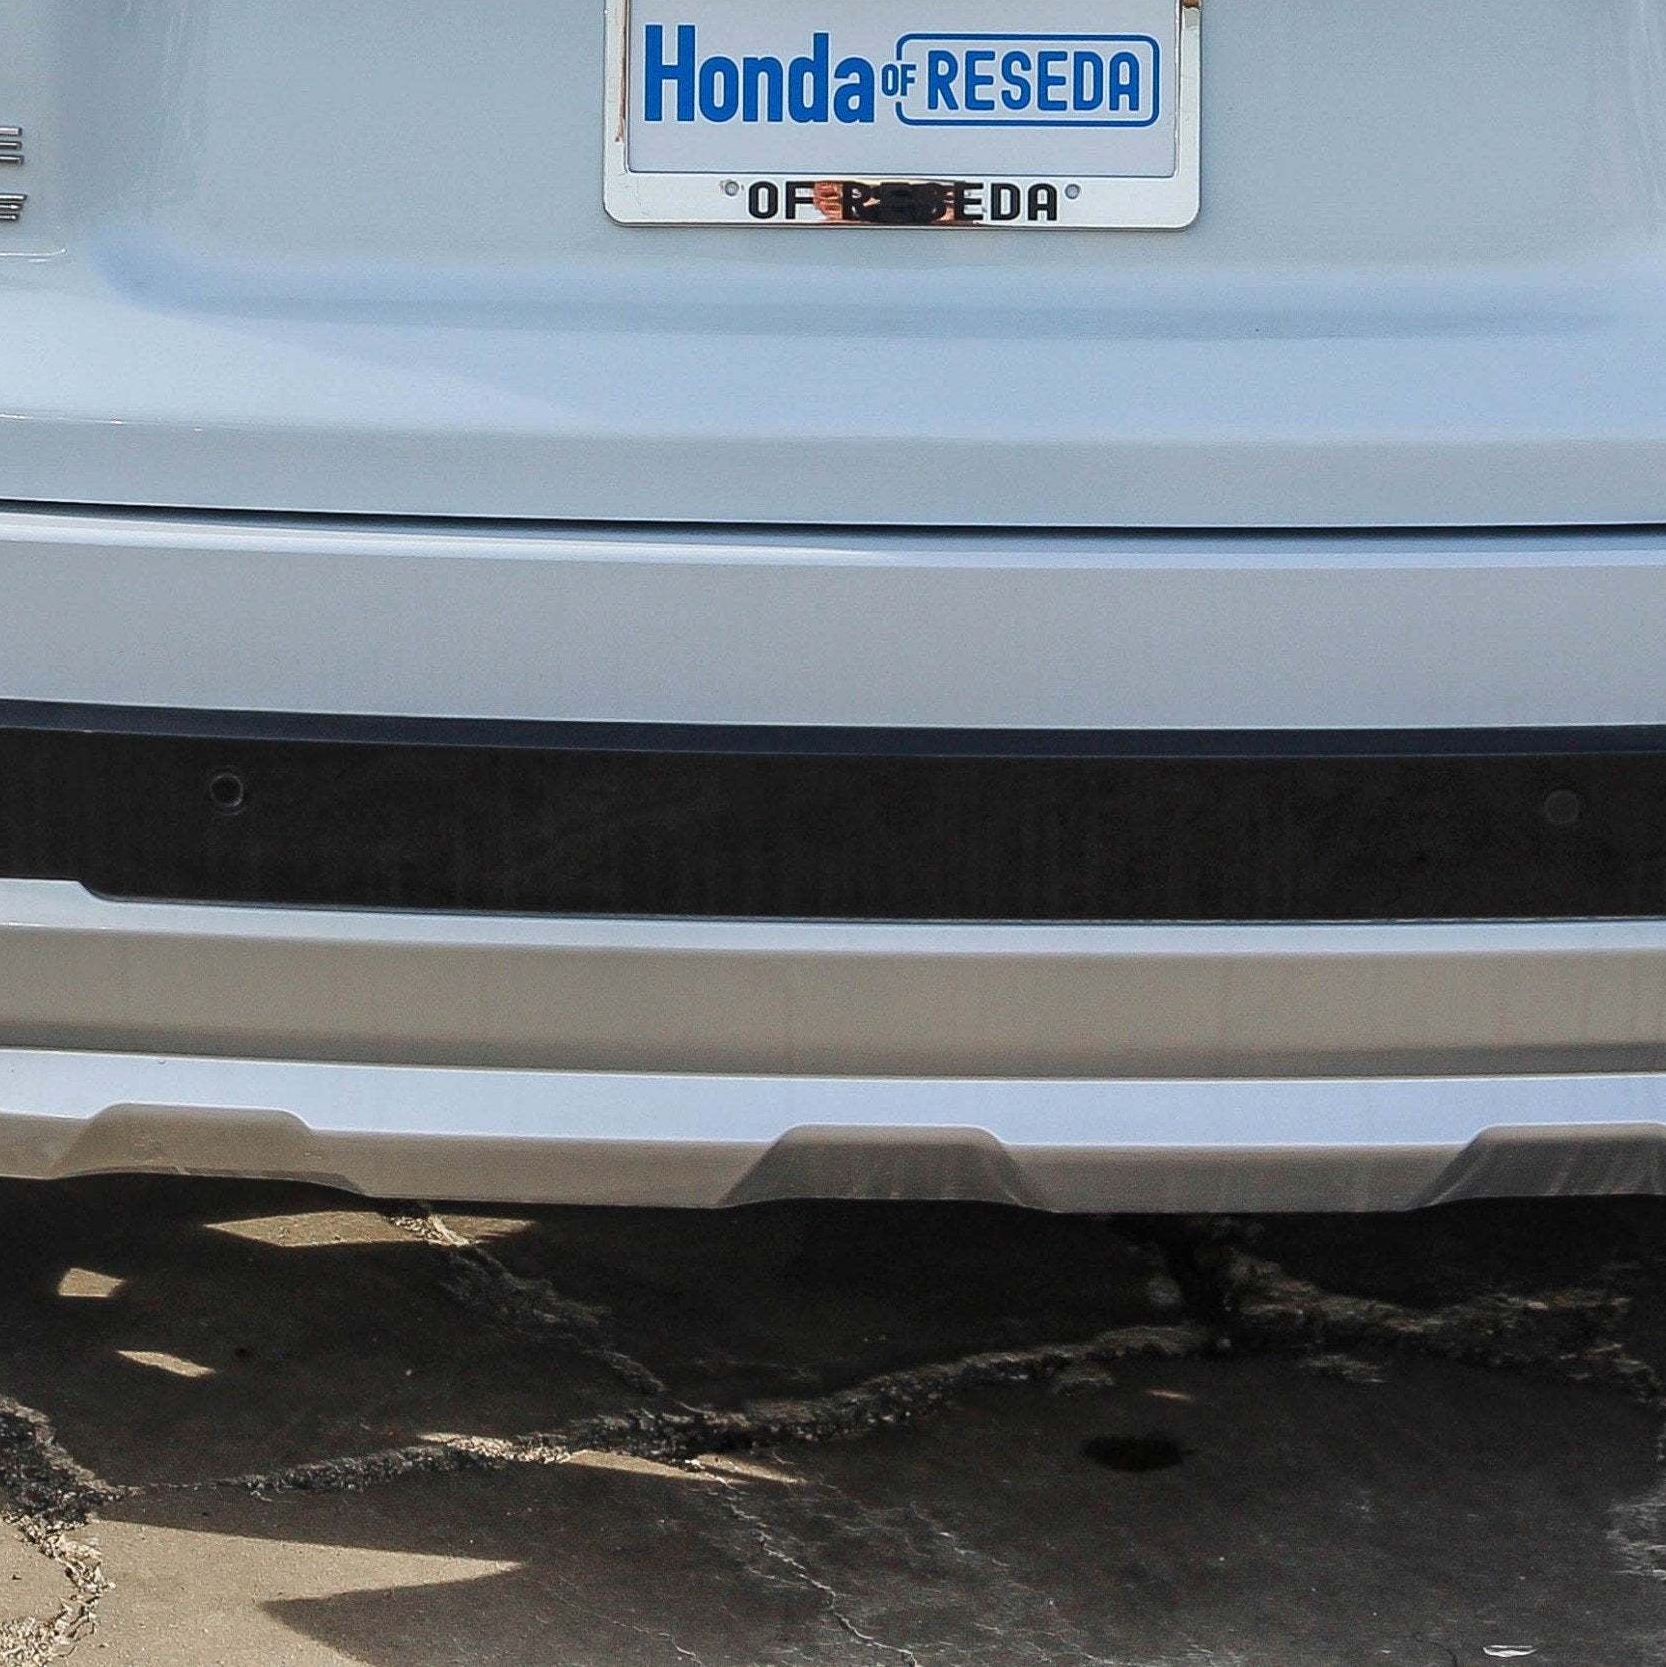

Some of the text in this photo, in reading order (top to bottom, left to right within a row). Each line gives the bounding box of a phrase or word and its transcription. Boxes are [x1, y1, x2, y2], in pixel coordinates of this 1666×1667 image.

[643, 23, 1141, 124] Honda OF RESEDA
[747, 181, 816, 220] OF
